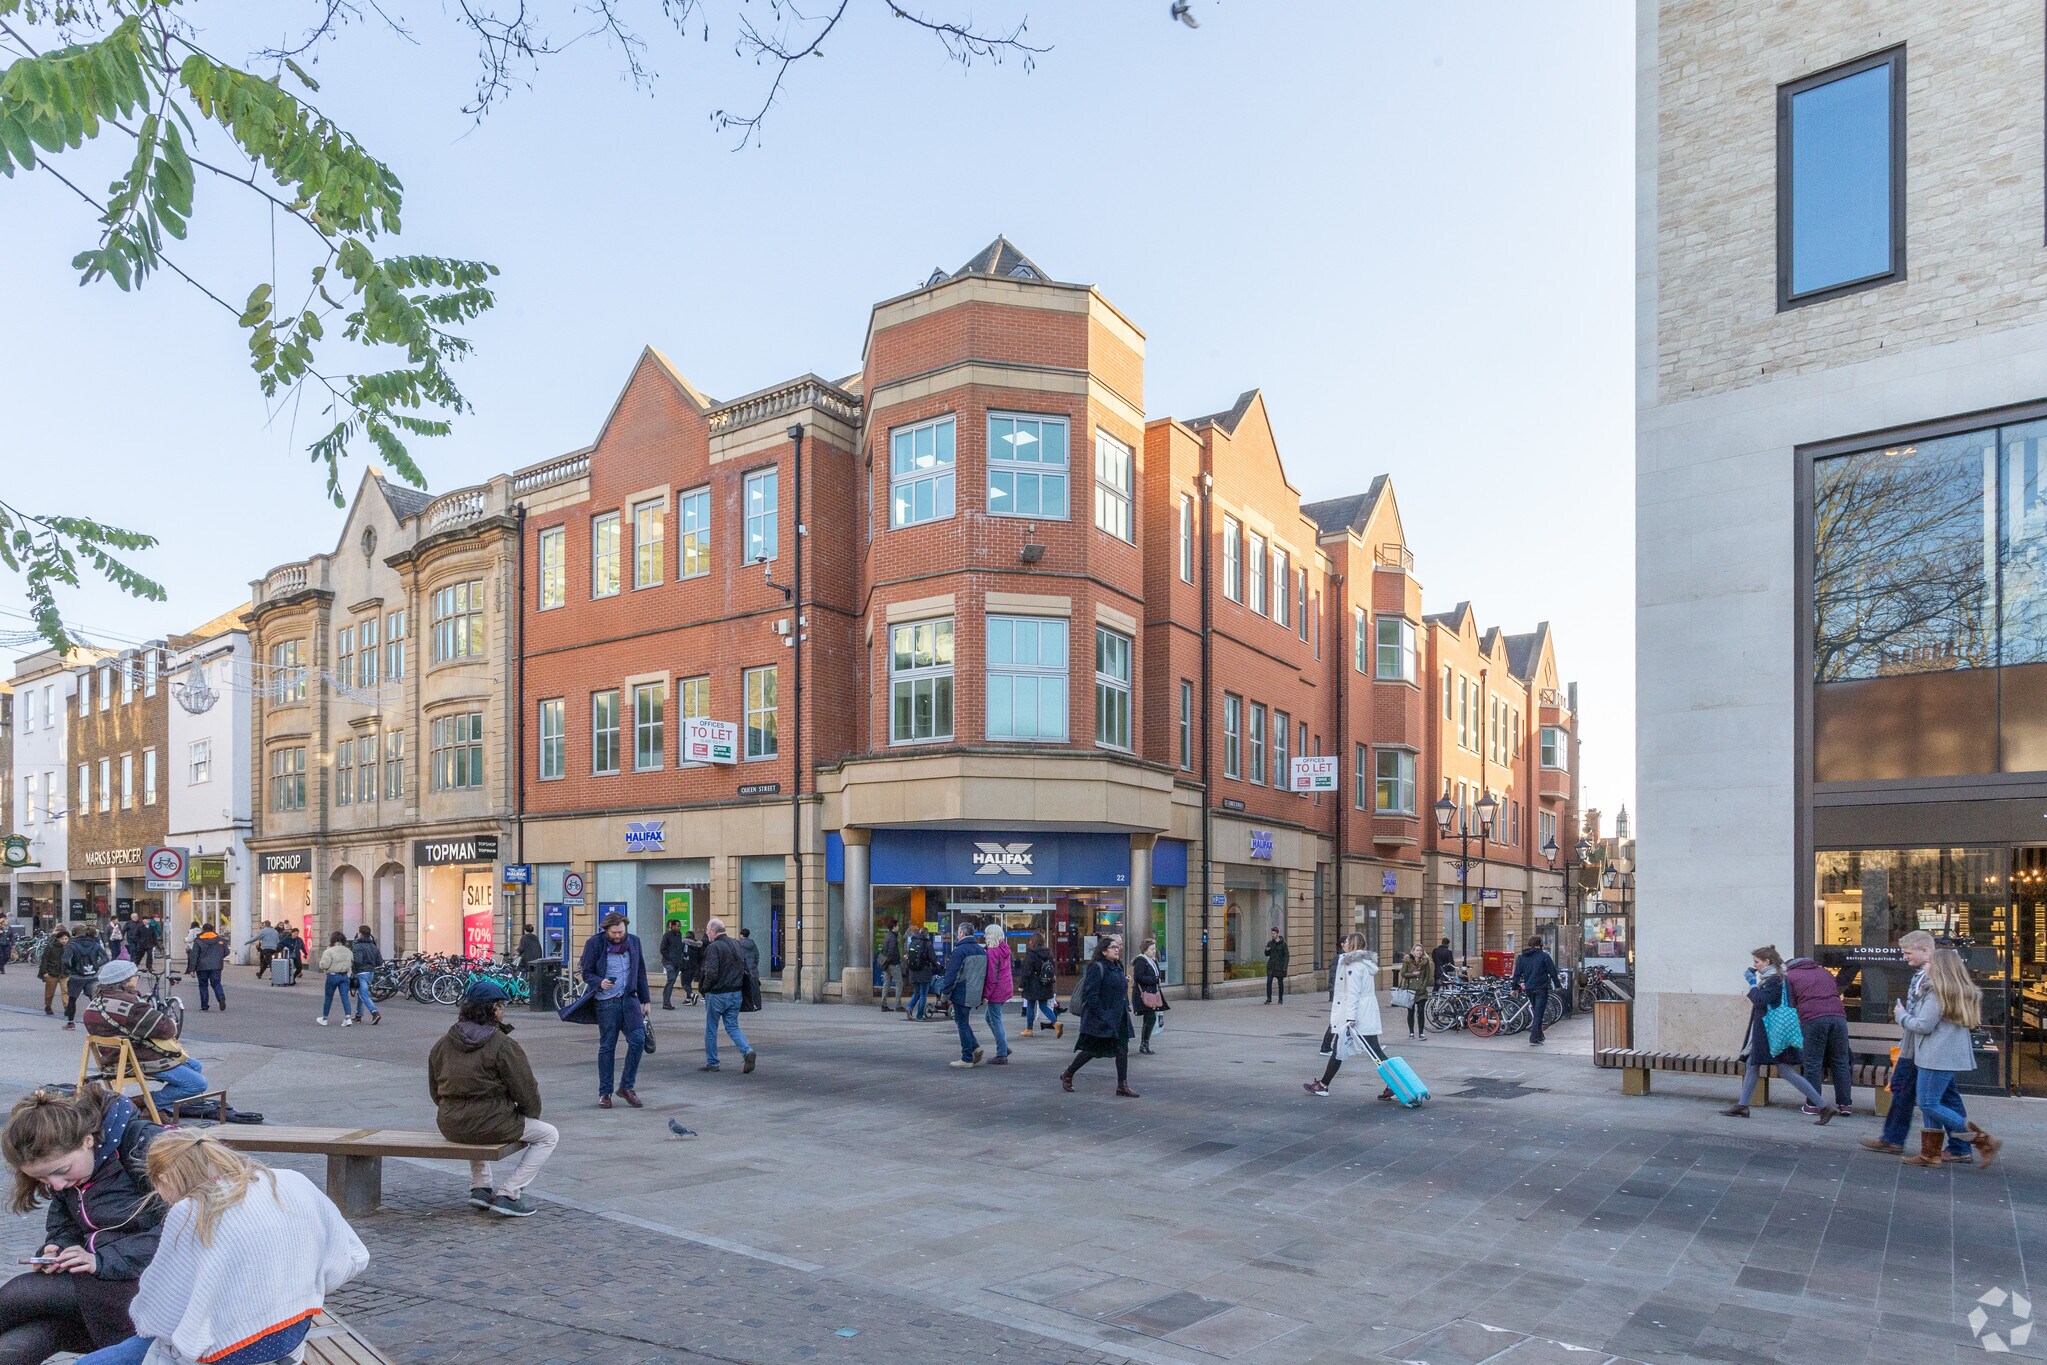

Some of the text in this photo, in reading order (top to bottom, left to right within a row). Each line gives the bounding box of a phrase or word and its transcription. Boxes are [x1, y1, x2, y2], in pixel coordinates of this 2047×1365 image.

[699, 720, 725, 729] OFFICES
[691, 726, 707, 739] TO
[711, 728, 733, 741] LET
[1295, 763, 1332, 773] TO LET
[625, 831, 662, 842] HALIFAX
[425, 842, 476, 862] TOPMAN
[1252, 839, 1273, 850] HALIFAX
[85, 851, 106, 866] MARKS
[111, 848, 142, 864] SPENCER
[266, 854, 301, 870] TOPSHOP
[973, 853, 1033, 864] HALIFAX
[467, 885, 492, 906] SALE
[467, 927, 492, 943] 70%
